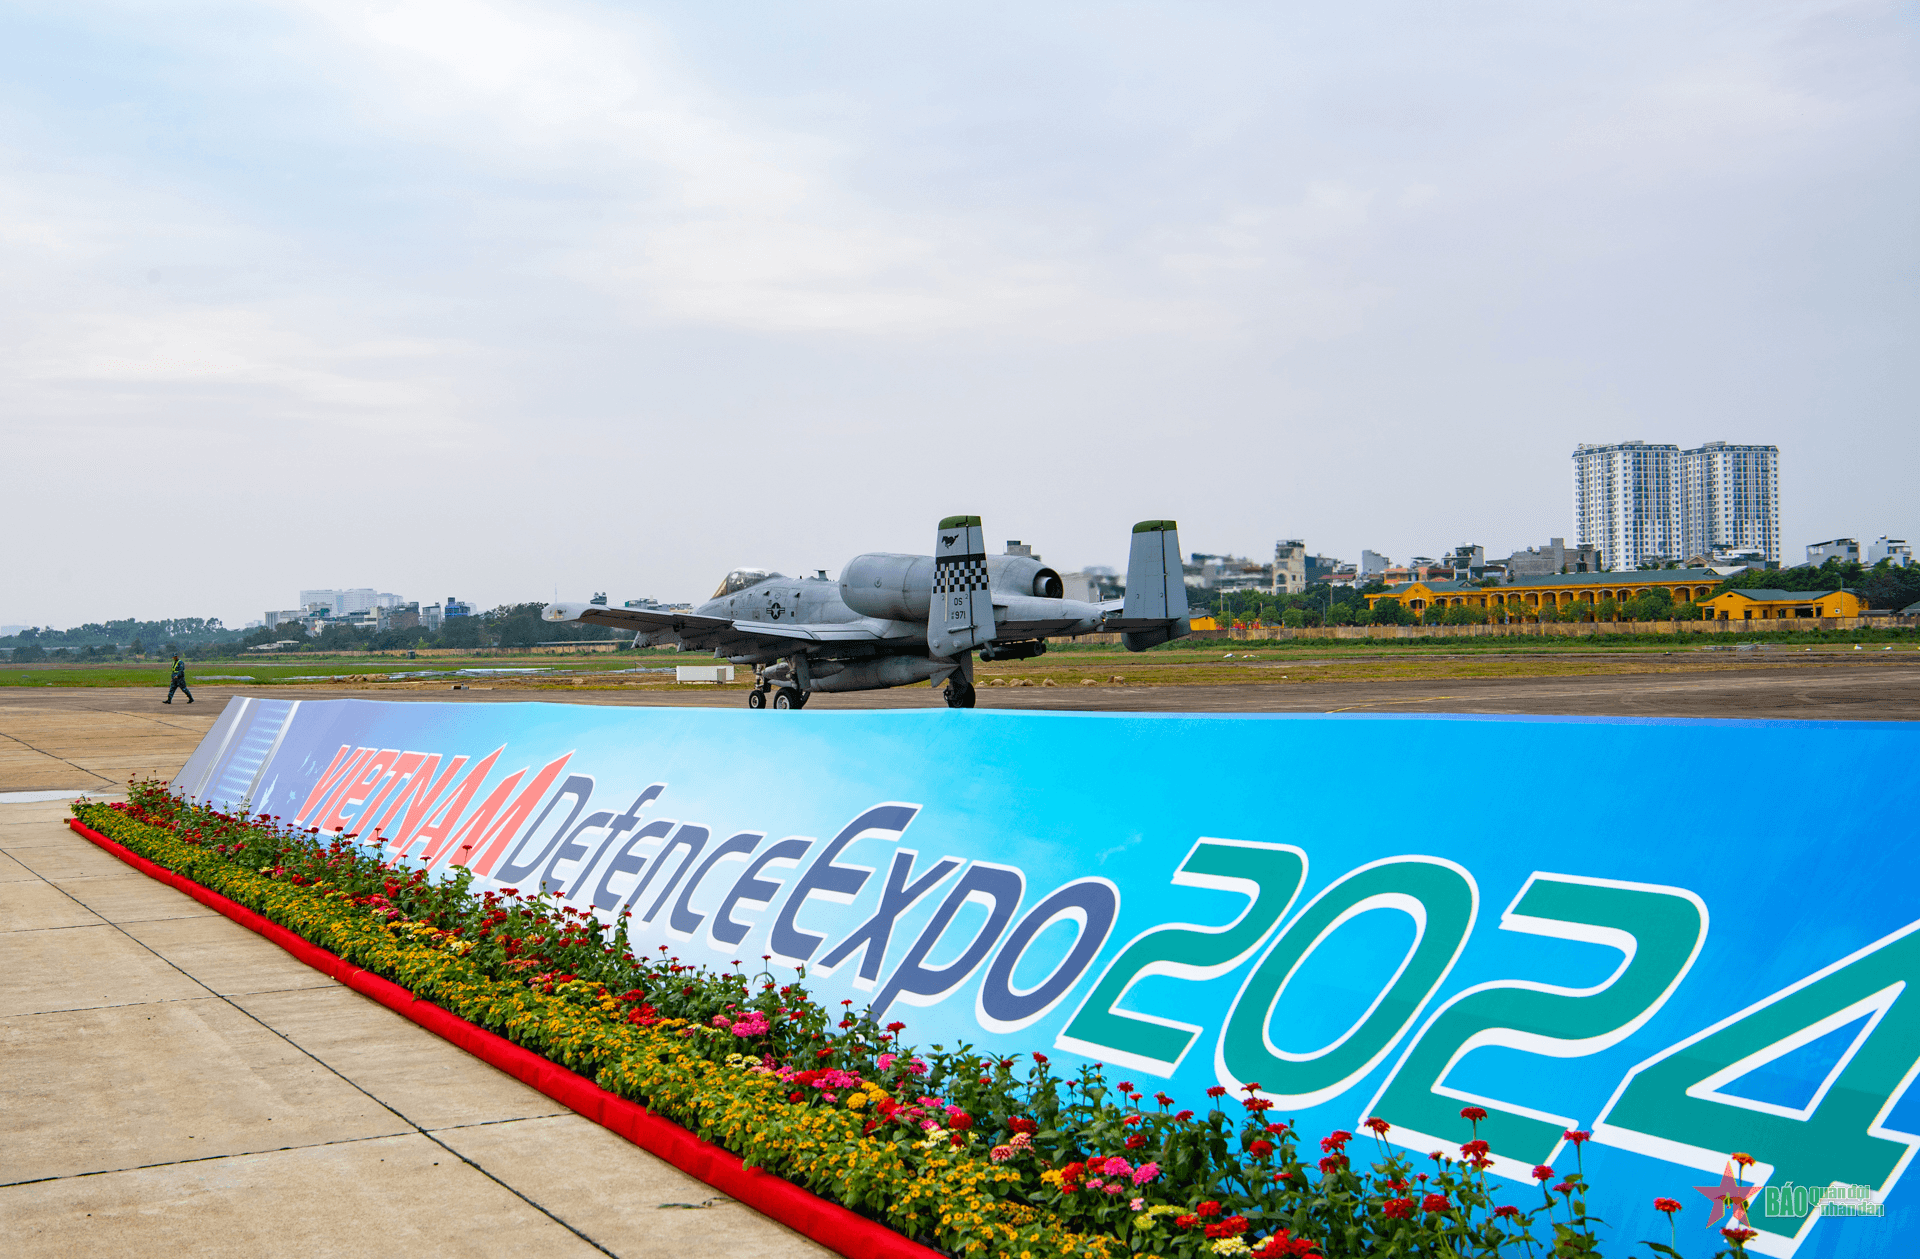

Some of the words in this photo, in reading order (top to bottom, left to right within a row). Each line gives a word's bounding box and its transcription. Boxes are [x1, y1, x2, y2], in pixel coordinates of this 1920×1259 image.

[953, 597, 963, 606] OS
[955, 611, 966, 620] 971
[1055, 836, 1920, 1259] 2024
